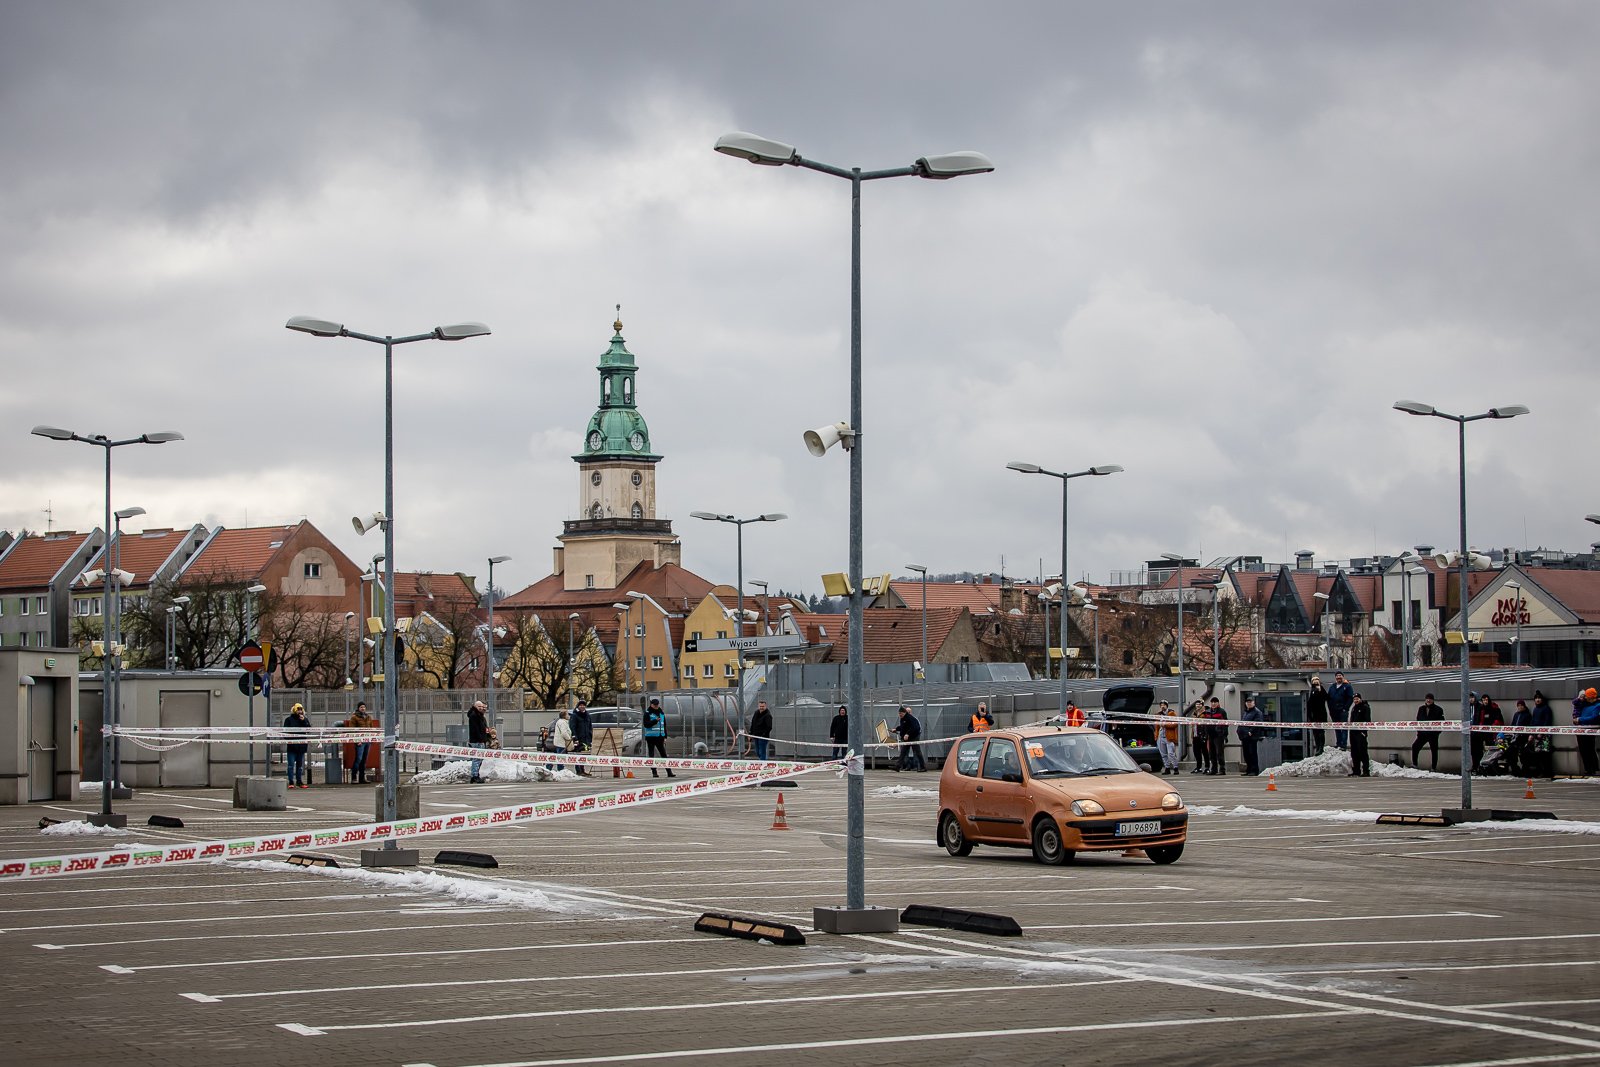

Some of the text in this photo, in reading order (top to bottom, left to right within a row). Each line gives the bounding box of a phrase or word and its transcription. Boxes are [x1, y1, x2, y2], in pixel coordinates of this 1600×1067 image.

[729, 639, 758, 649] Wyjazd
[1028, 747, 1045, 758] 19
[419, 820, 443, 833] MRF
[342, 829, 367, 843] MRF
[257, 839, 286, 852] MRF
[165, 849, 196, 862] MRF
[64, 858, 98, 872] MRF
